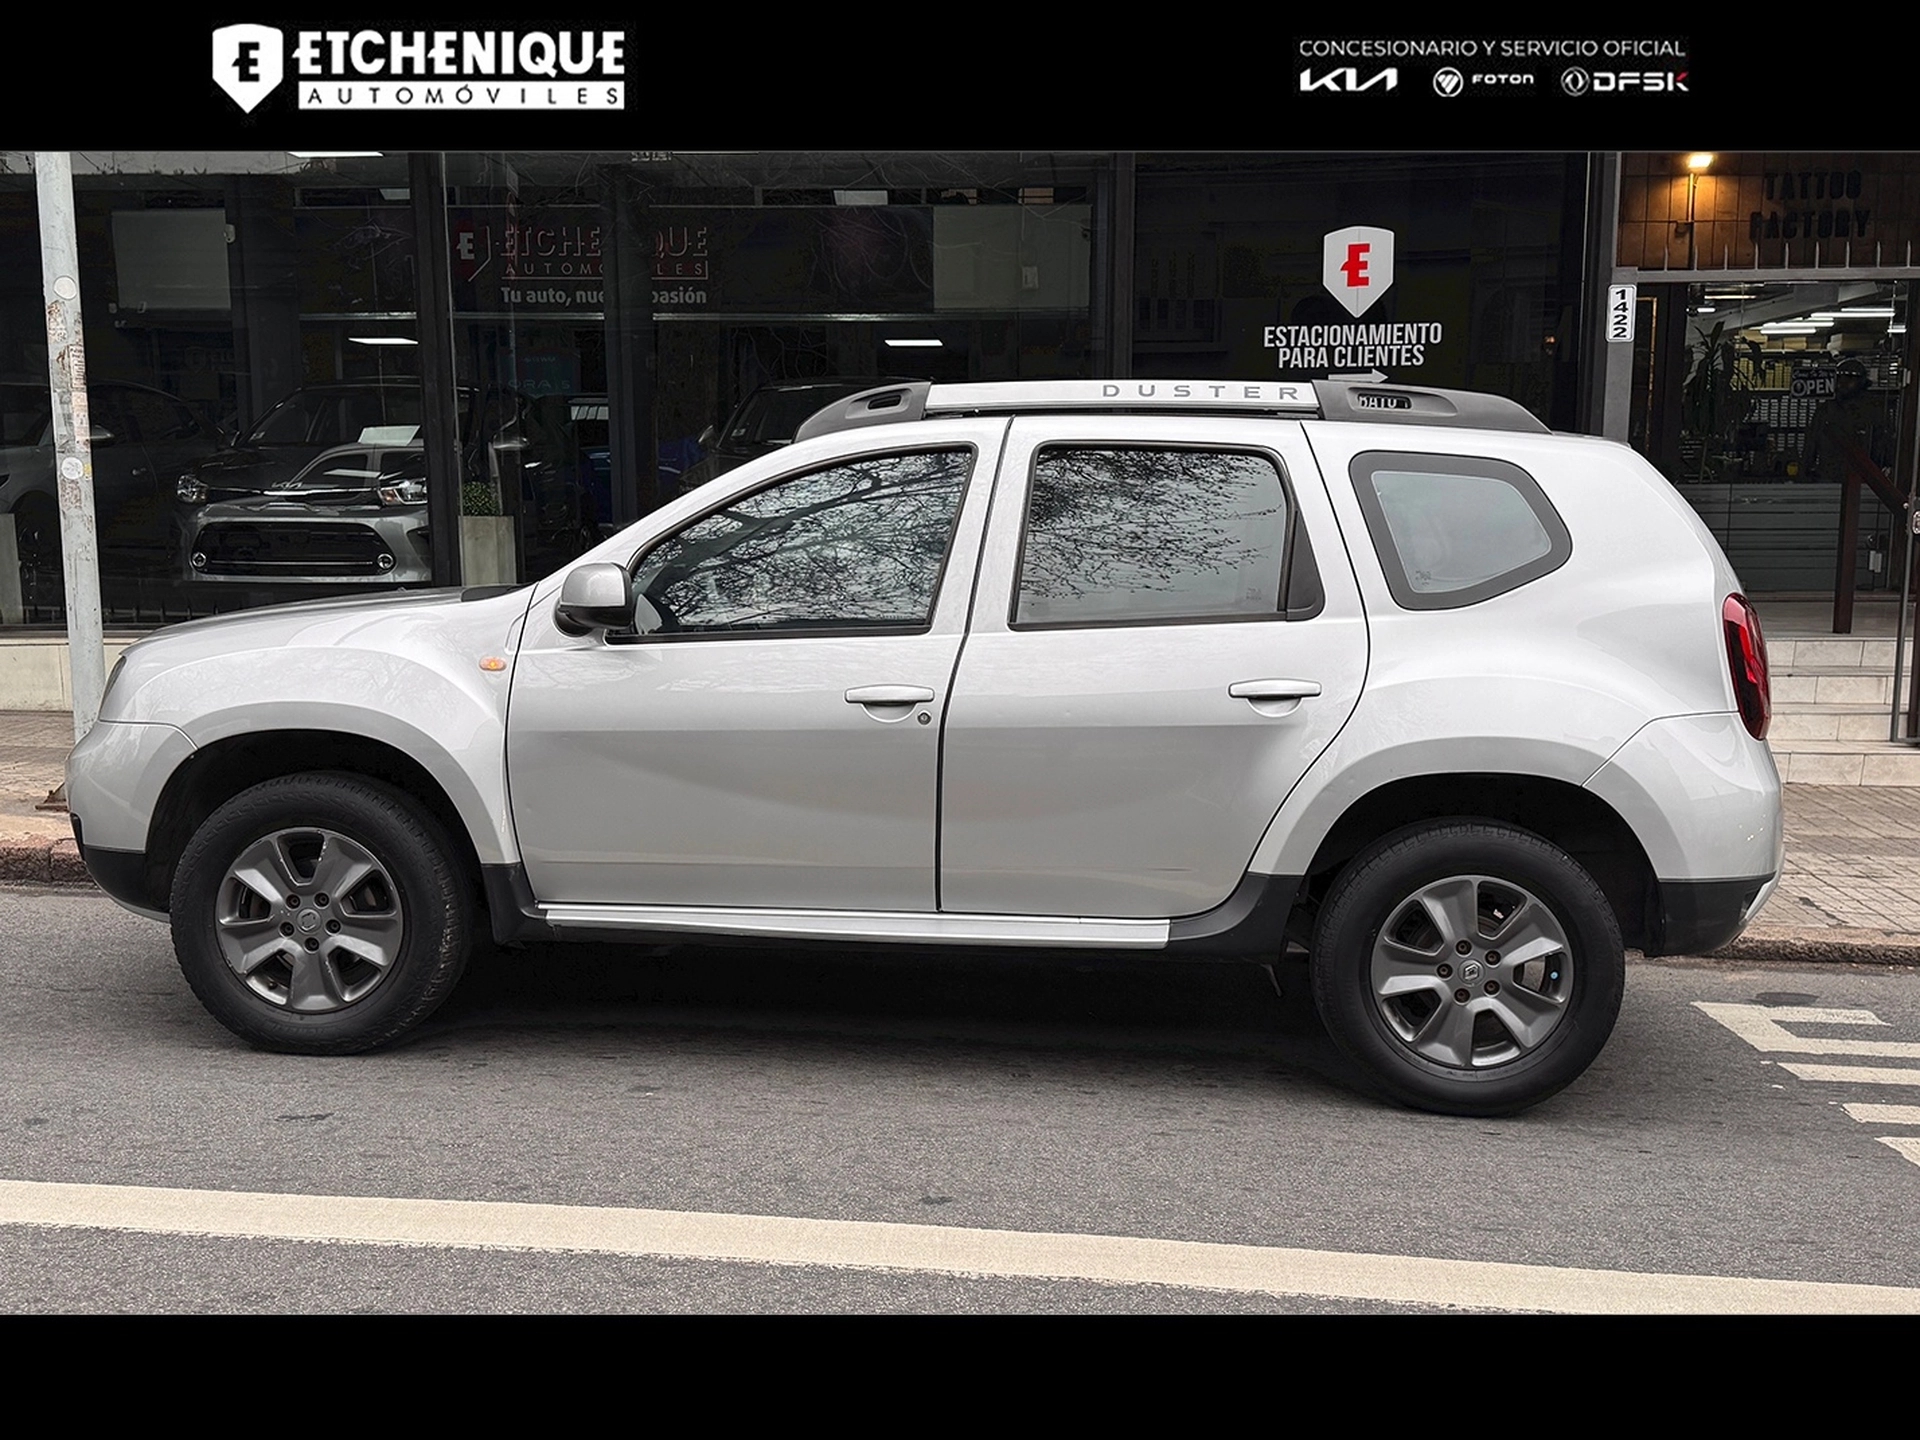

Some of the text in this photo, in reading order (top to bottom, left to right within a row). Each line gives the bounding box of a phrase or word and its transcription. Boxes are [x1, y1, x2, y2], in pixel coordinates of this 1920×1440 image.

[1764, 170, 1861, 199] TATTOO
[1750, 210, 1870, 238] FACTORY
[505, 262, 703, 275] AUTOMLES
[1340, 242, 1371, 287] E
[500, 287, 522, 304] Tu
[526, 287, 572, 307] auto,
[1613, 288, 1629, 338] 1422
[1264, 322, 1442, 347] ESTACIONAMIENTO
[1278, 345, 1425, 369] PARA CLIENTES
[1102, 384, 1299, 400] DUSTER
[1791, 378, 1835, 397] OPEN
